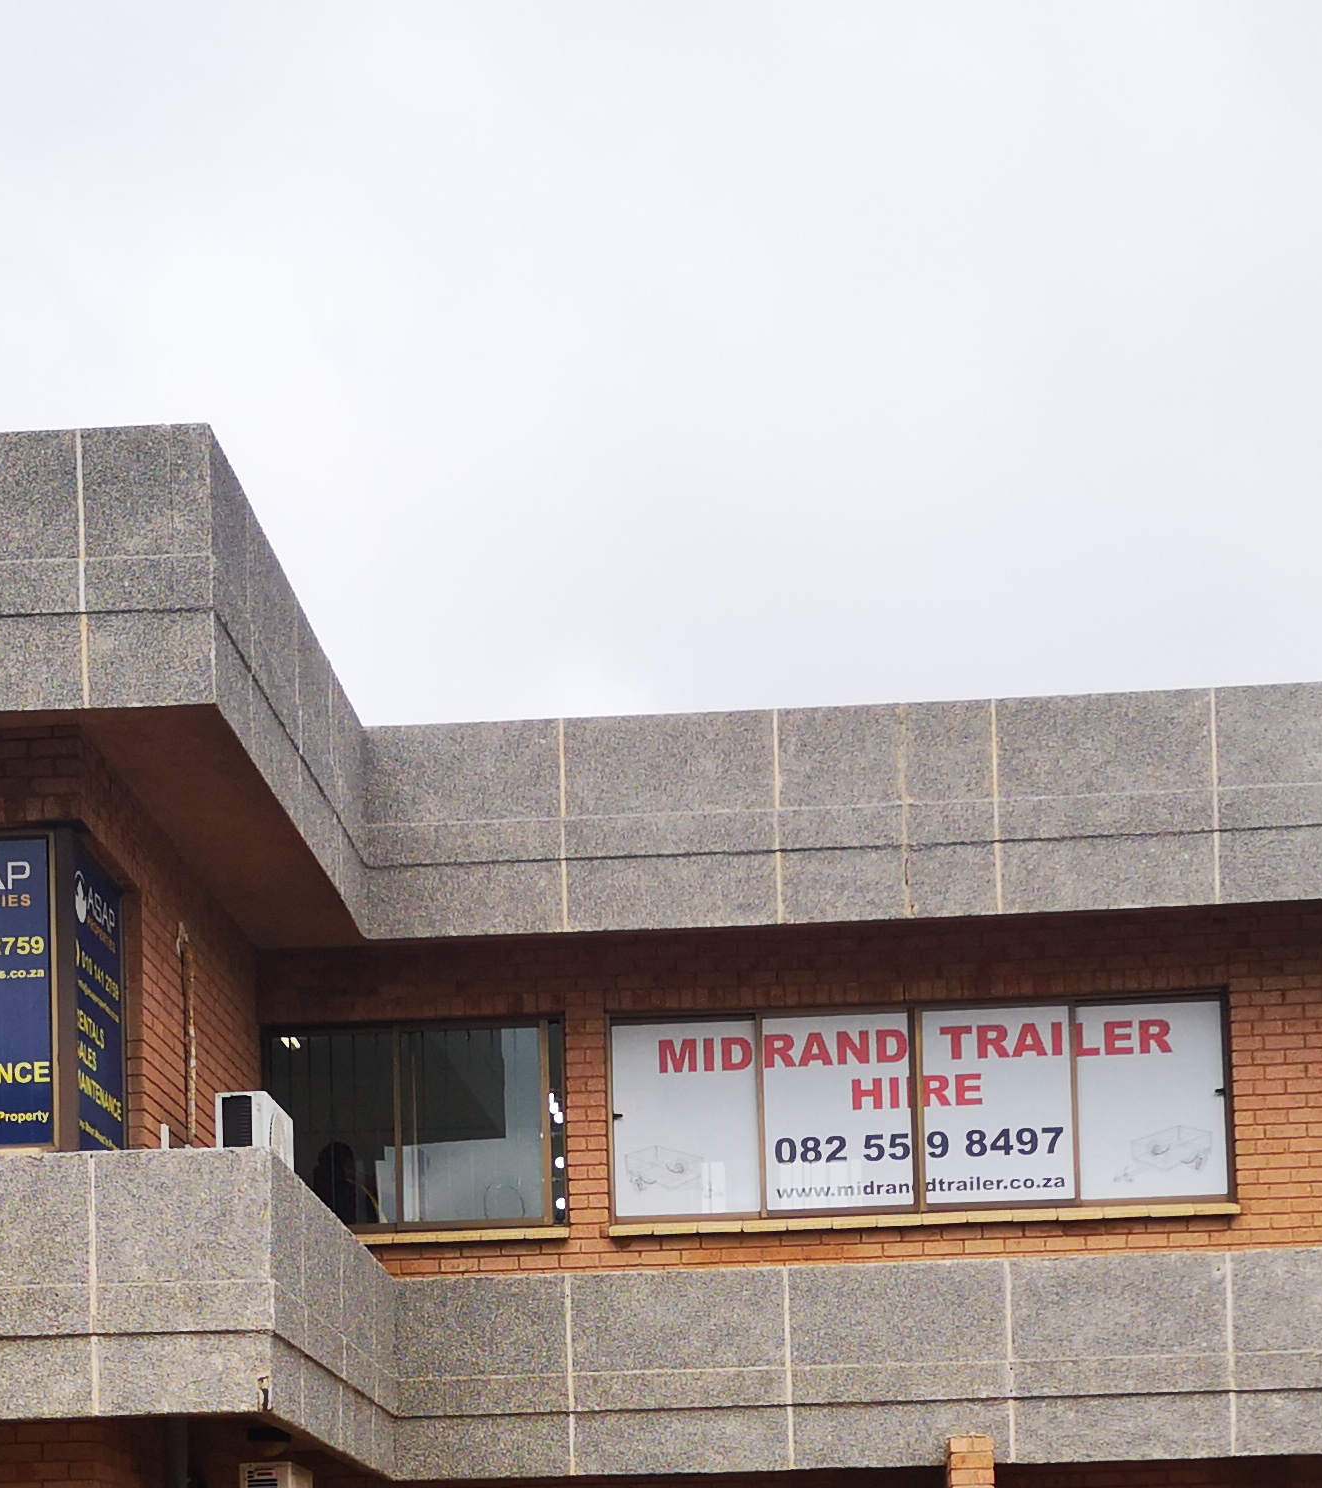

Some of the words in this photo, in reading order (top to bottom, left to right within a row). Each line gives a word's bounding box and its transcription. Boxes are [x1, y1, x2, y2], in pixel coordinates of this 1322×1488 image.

[87, 886, 116, 933] ASAP
[658, 1029, 909, 1074] MIDRAND
[939, 1019, 1173, 1060] TRAILER
[851, 1073, 984, 1111] HIRE
[775, 1135, 848, 1164] 082
[965, 1126, 1064, 1157] 8497
